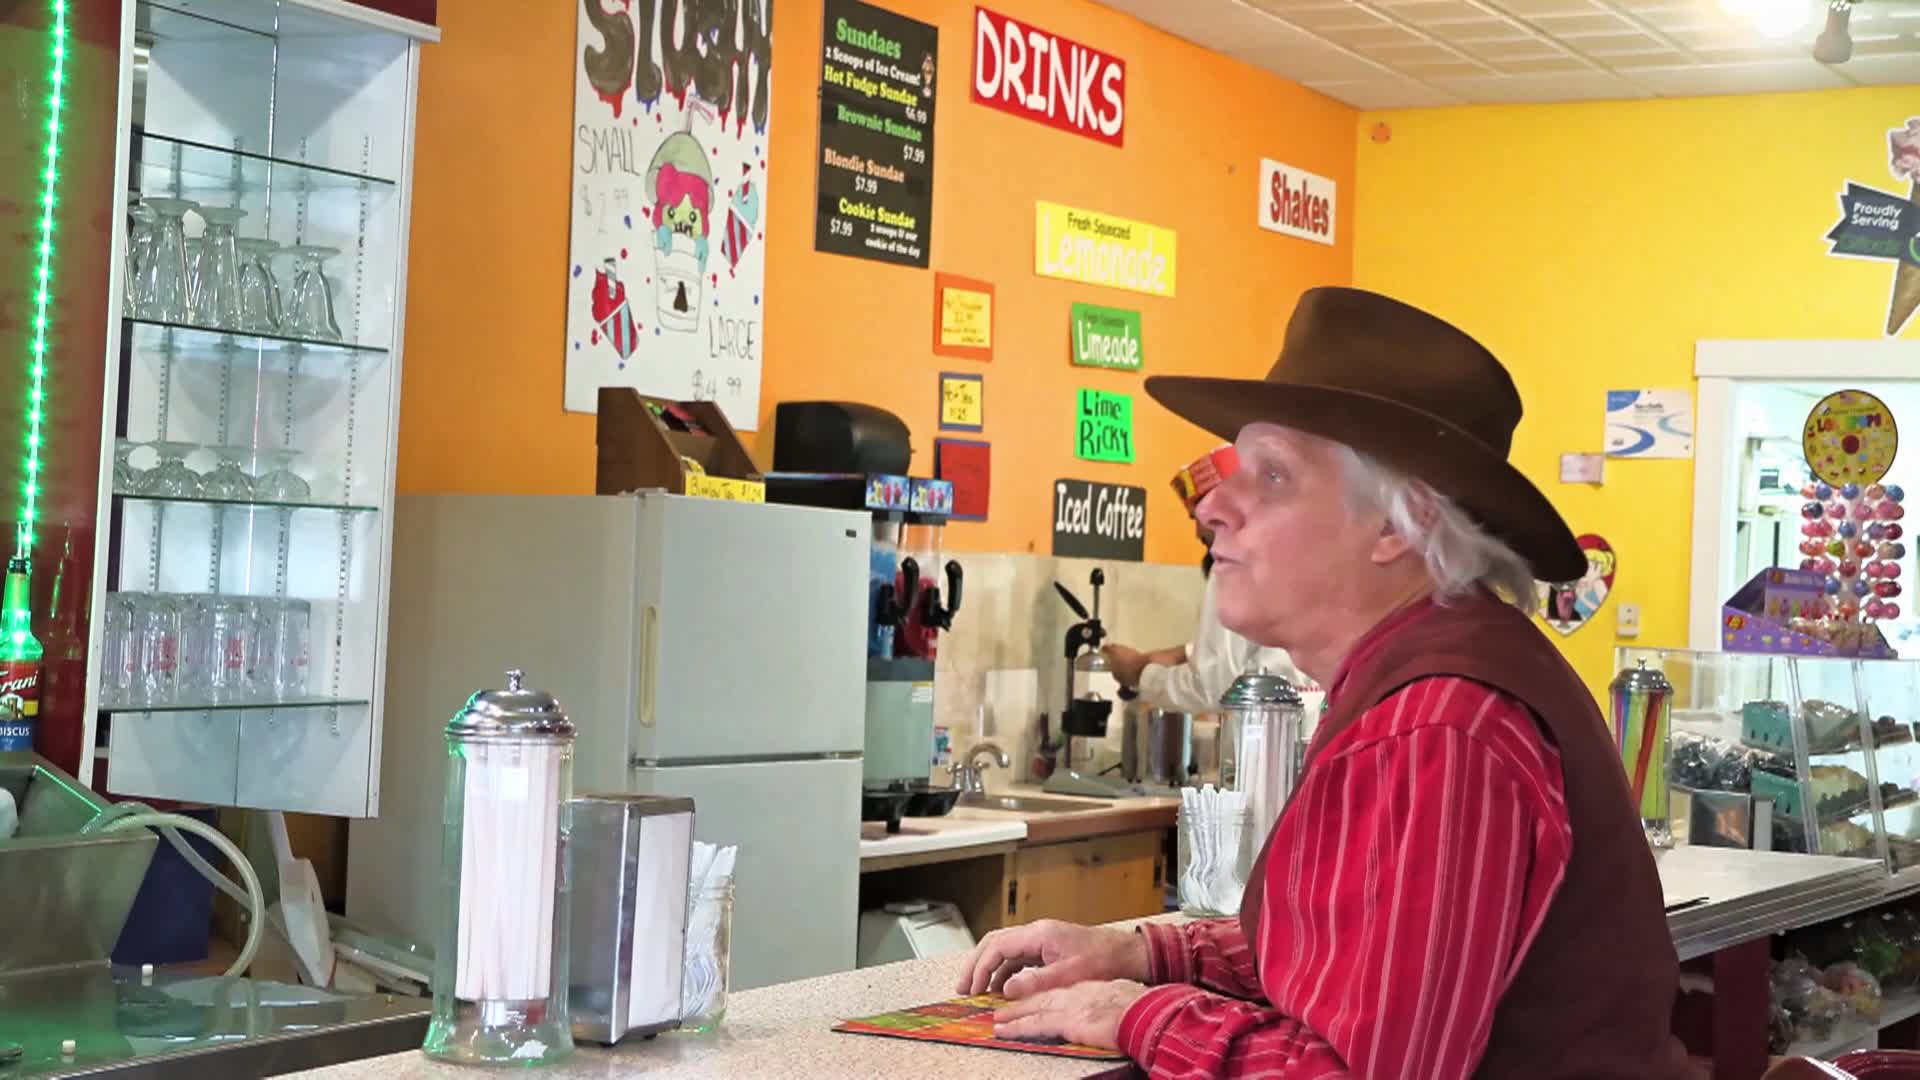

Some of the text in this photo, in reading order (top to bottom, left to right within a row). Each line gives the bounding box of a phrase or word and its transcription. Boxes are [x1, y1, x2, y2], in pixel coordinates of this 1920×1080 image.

[836, 17, 902, 59] Sundaes
[833, 46, 863, 70] Scoops
[864, 59, 874, 72] of
[876, 61, 889, 76] Ice
[975, 9, 1123, 137] DRINKS
[824, 64, 918, 107] Hot Fudge Sundae
[837, 103, 922, 142] Brownie Sundae
[578, 124, 640, 176] SMALL
[824, 148, 905, 183] Blondie Sundae
[903, 144, 925, 164] $7.99
[855, 175, 878, 194] $7.99
[839, 197, 916, 229] Cookie Sundae
[1270, 170, 1329, 236] Shakes
[1853, 202, 1902, 219] Proudly
[830, 218, 853, 237] $7.99
[1067, 211, 1091, 231] Fresh
[1851, 213, 1899, 231] Serving
[1043, 207, 1166, 292] Lemonade
[709, 315, 757, 360] LARGE
[1078, 319, 1140, 367] Limeade
[1083, 389, 1121, 420] Lime
[1056, 482, 1144, 541] Iced Coffee
[0, 669, 39, 693] rani
[0, 727, 30, 737] ISCUS
